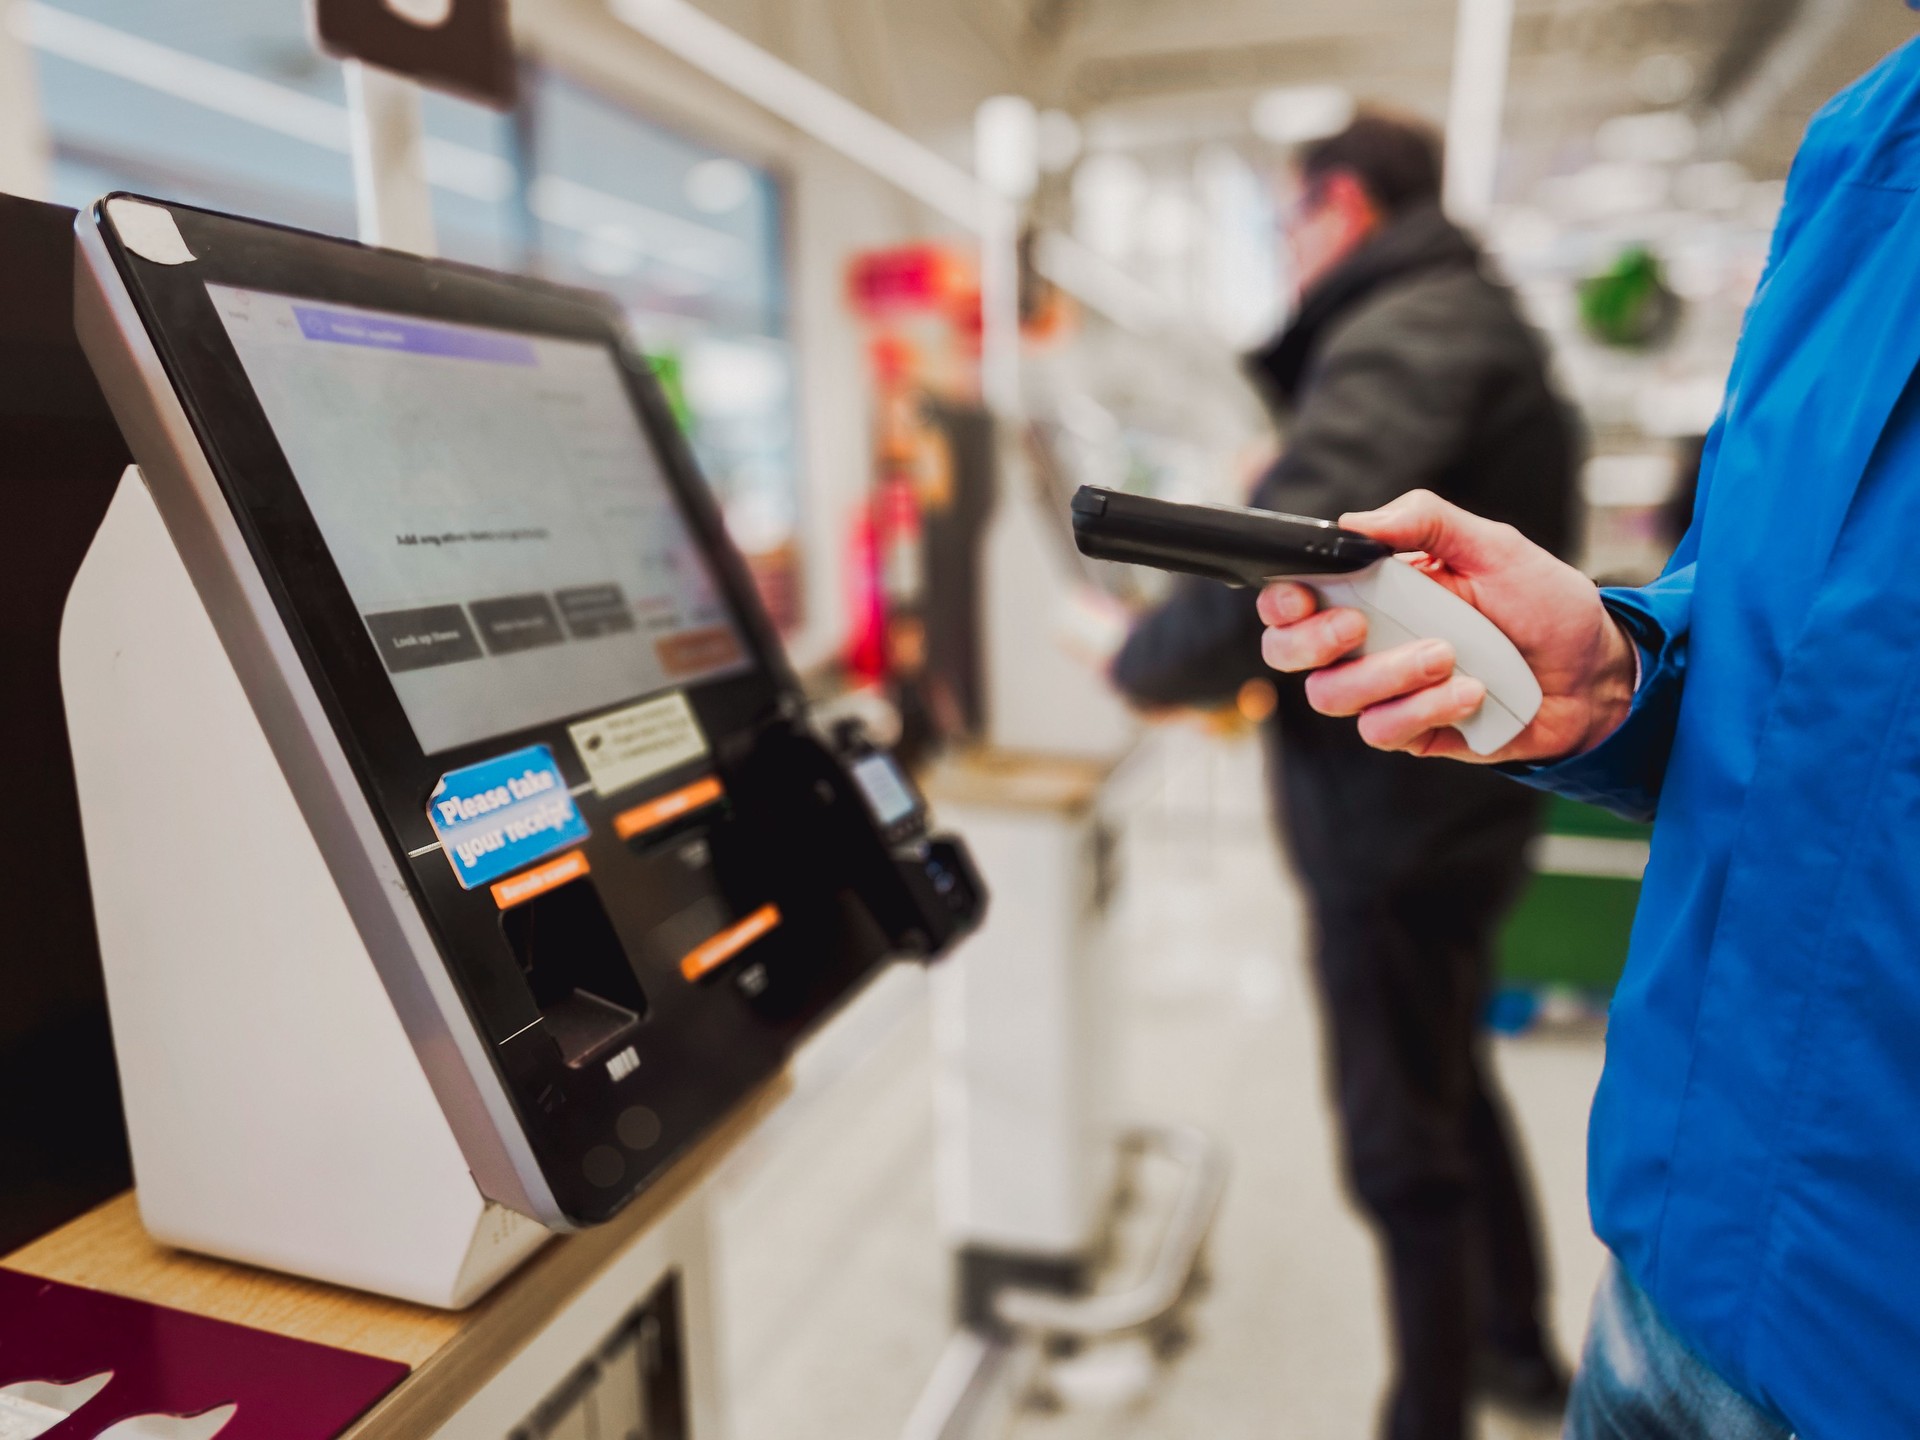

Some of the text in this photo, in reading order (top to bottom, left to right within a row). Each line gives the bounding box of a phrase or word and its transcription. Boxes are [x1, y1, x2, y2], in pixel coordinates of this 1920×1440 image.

[437, 770, 555, 825] Please take
[456, 798, 574, 868] your receipt
